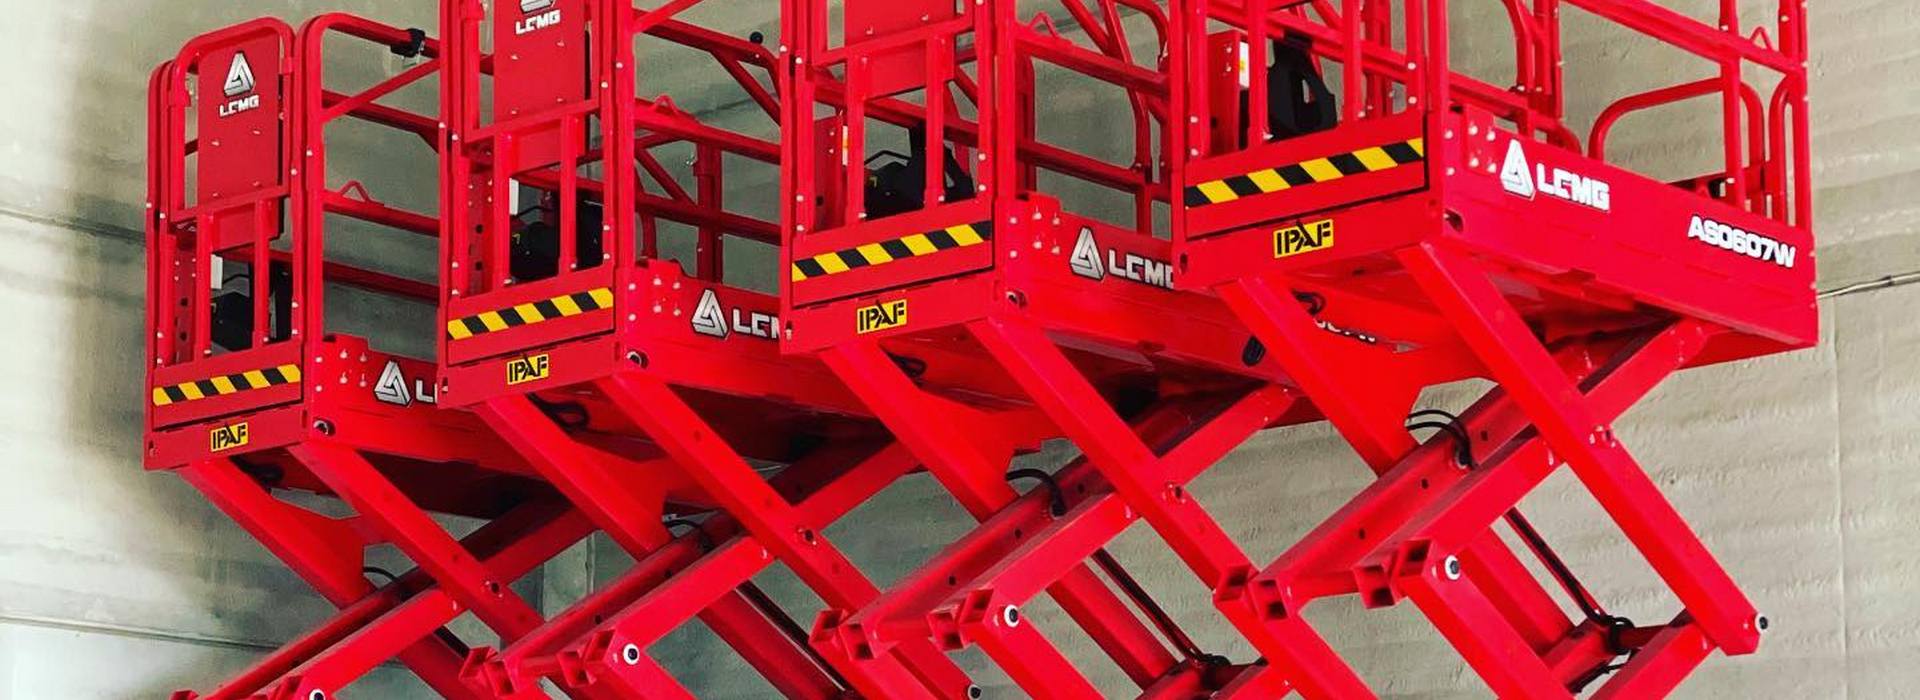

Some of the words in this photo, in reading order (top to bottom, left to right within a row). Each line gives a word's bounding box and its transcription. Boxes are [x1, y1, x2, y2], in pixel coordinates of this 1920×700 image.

[1276, 220, 1331, 255] IPAF
[1687, 215, 1796, 268] AS0607W
[859, 300, 905, 332] IPAF
[509, 355, 547, 383] IPAF
[212, 424, 246, 449] IPAF
